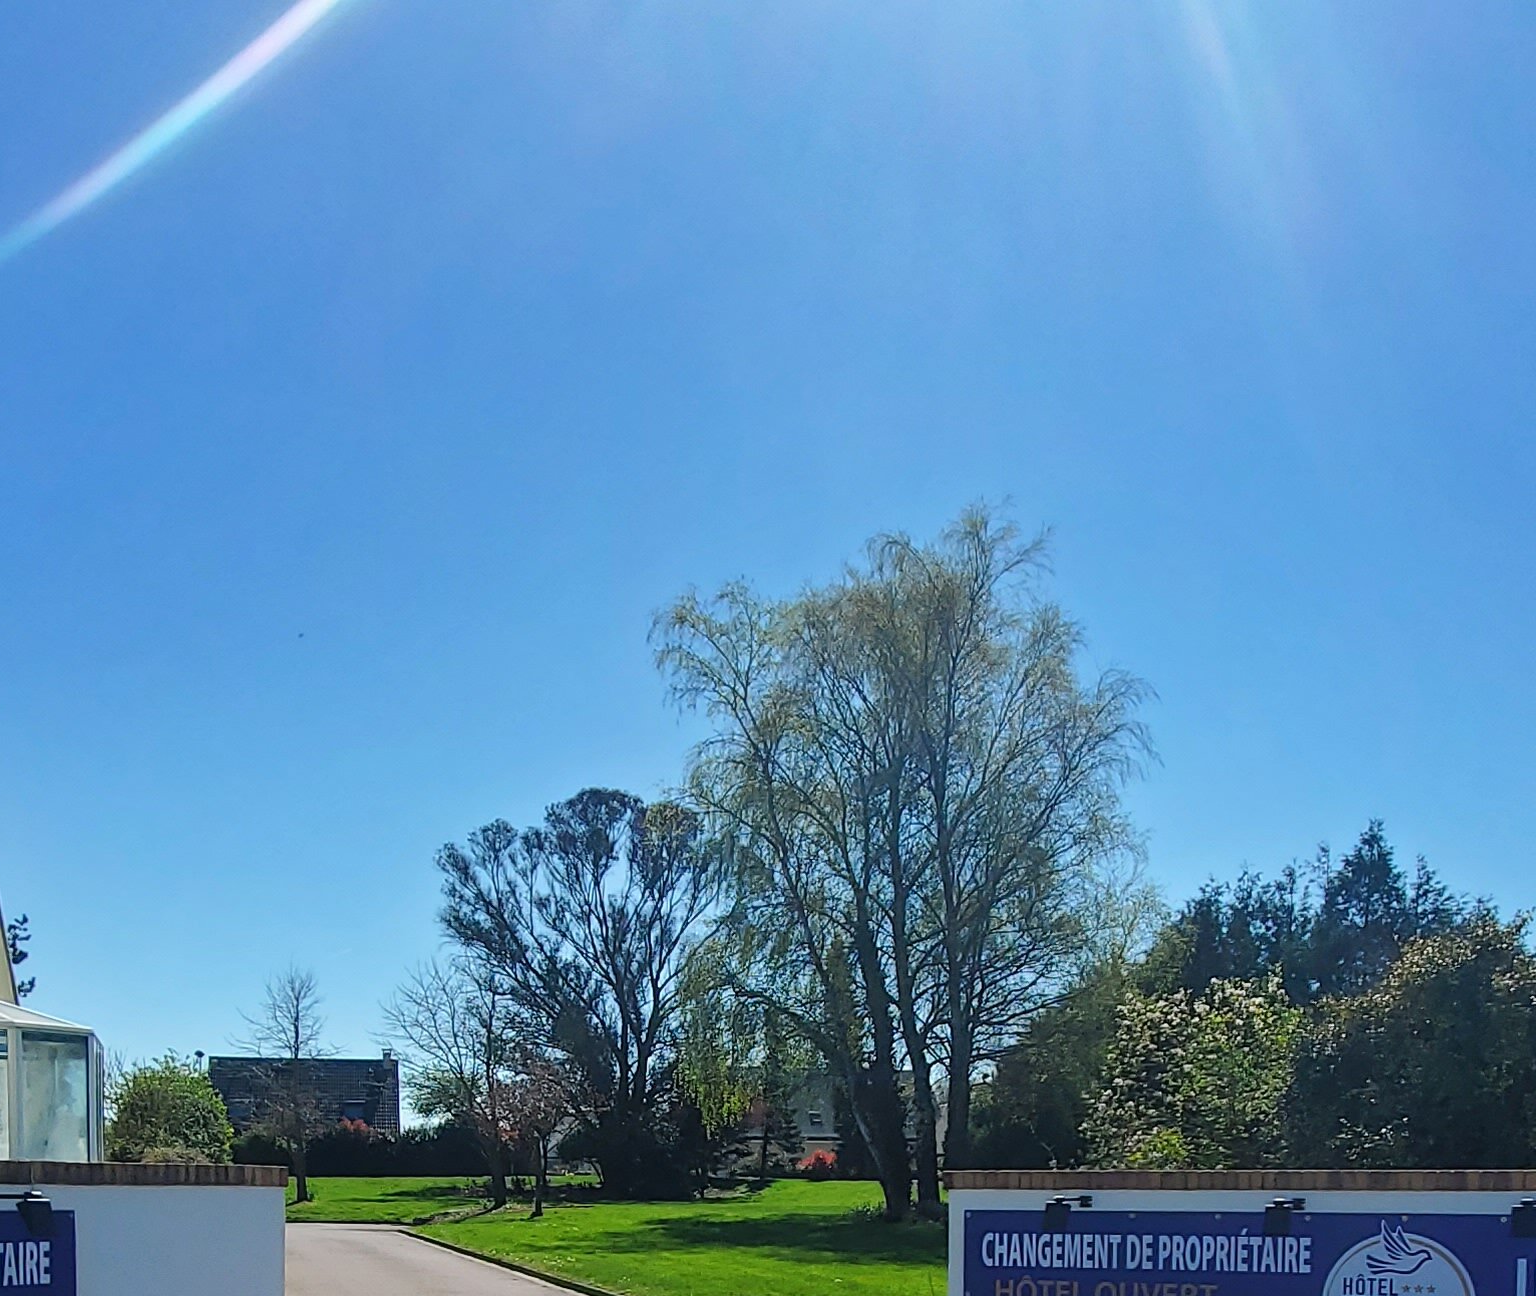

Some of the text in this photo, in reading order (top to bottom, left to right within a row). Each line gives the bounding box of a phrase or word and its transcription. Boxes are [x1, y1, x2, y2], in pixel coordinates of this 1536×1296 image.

[981, 1228, 1312, 1274] CHANGEMENT DE PROPRIÉTAIRE
[1343, 1273, 1398, 1296] HÔTEL
